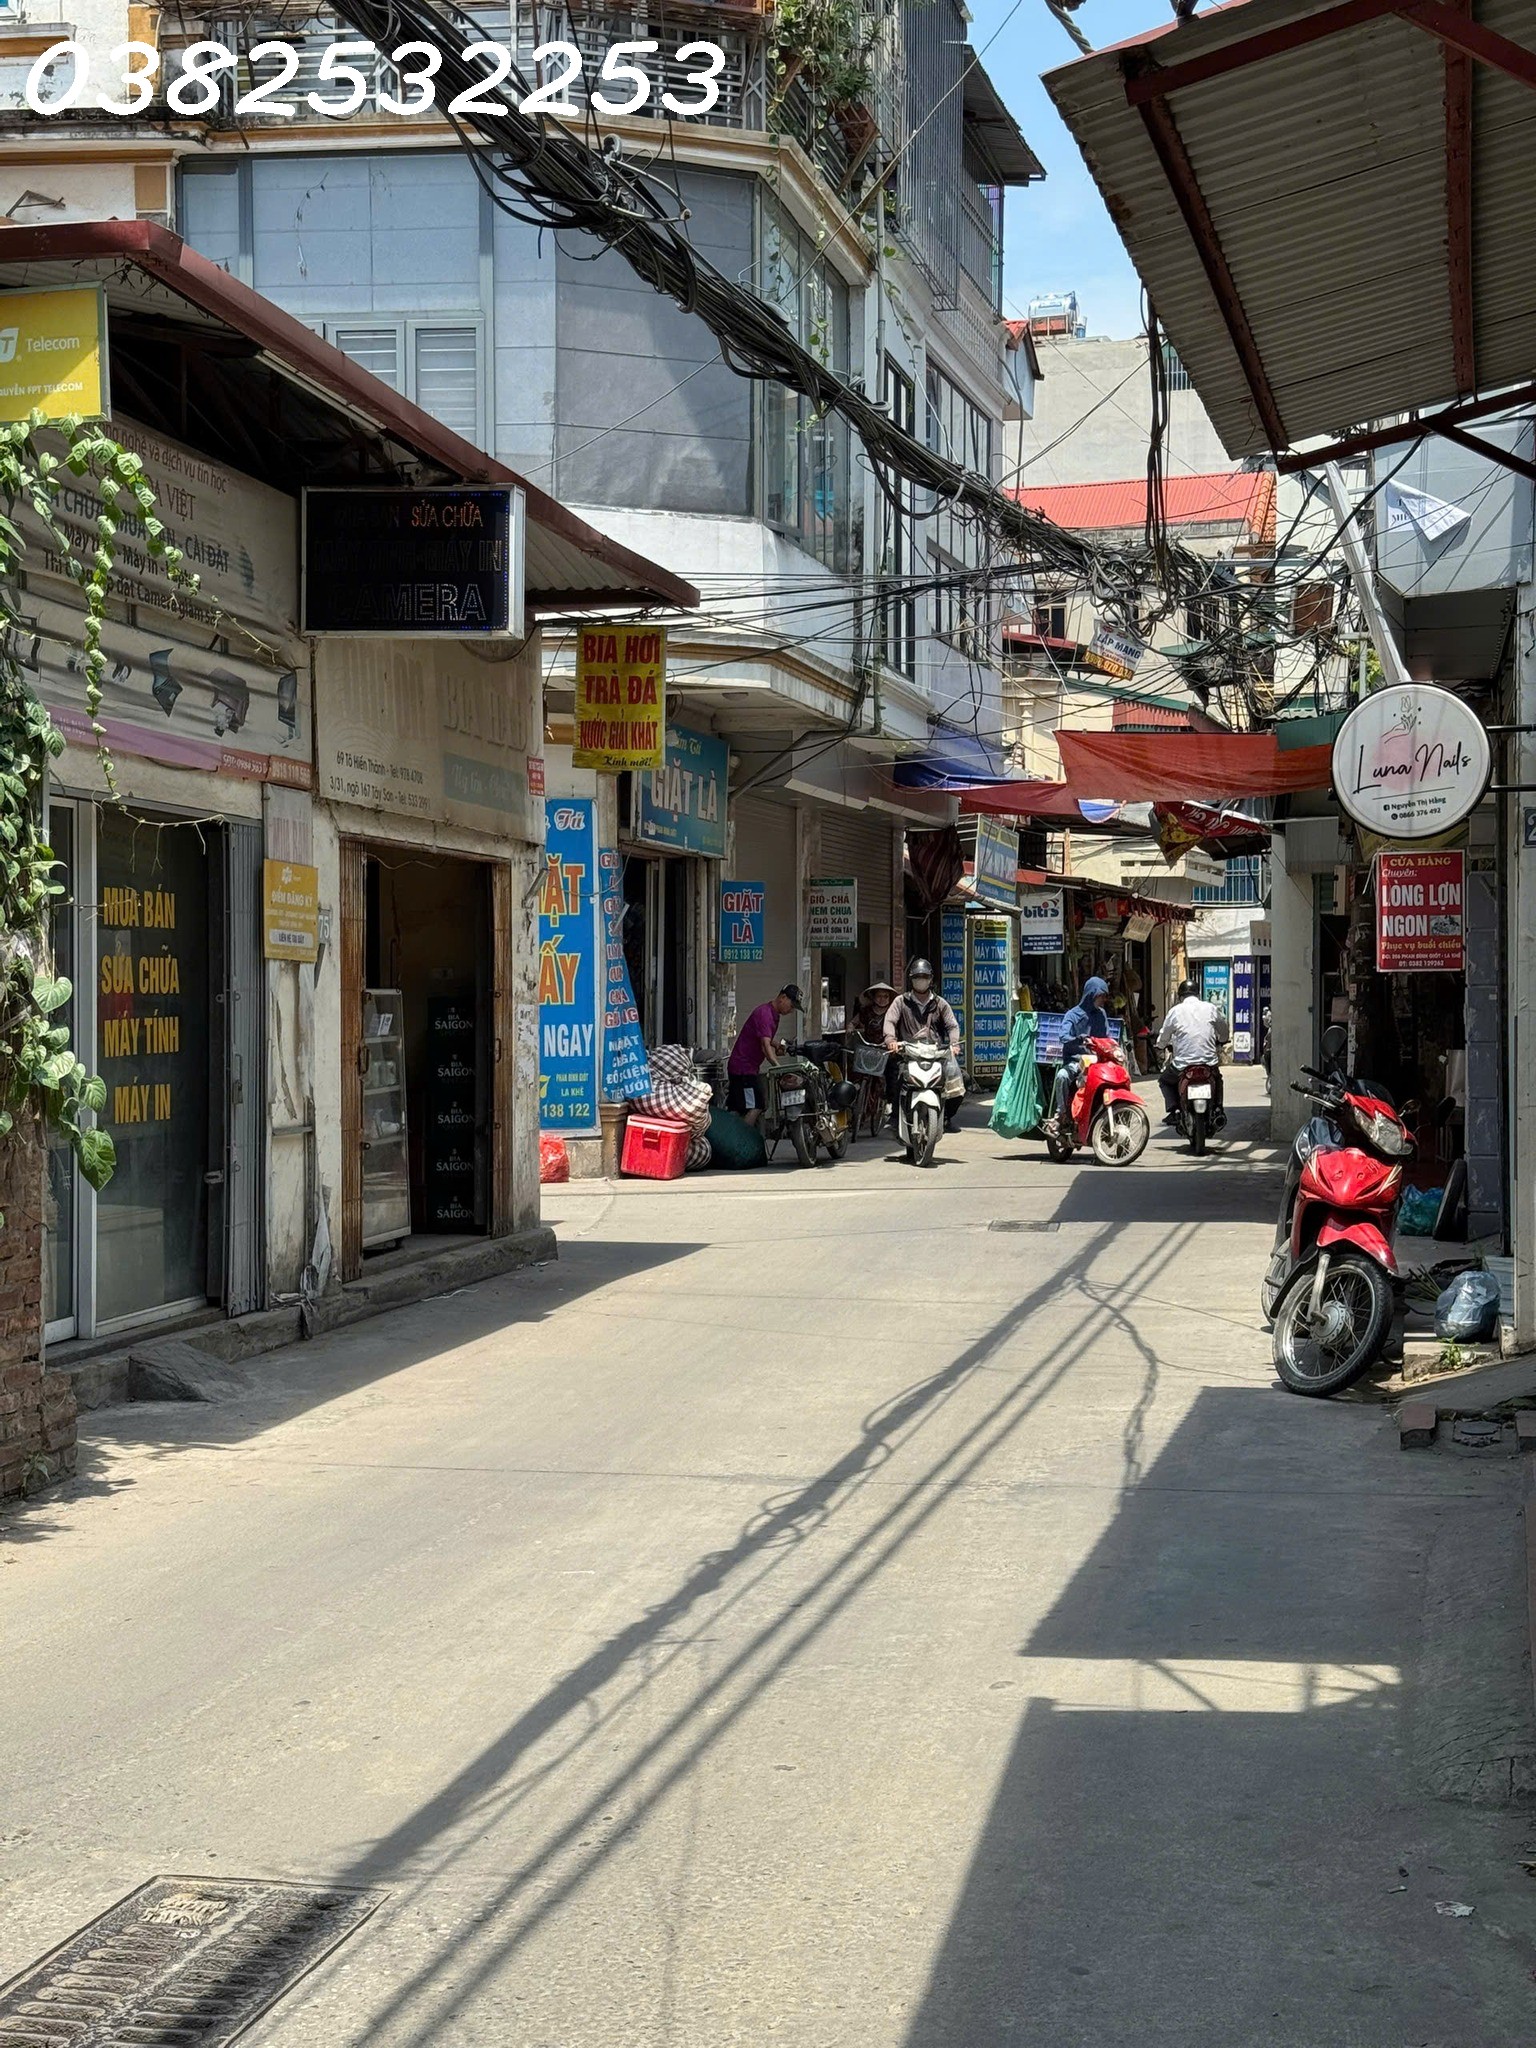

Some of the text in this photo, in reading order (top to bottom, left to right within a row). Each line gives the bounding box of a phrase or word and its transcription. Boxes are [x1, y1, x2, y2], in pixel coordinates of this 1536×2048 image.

[27, 336, 80, 353] Telecom
[27, 384, 42, 395] FPT
[43, 381, 83, 394] TELECOM
[162, 449, 182, 472] dịch
[197, 464, 209, 484] tin
[166, 483, 196, 522] VIỆT
[411, 498, 484, 528] SỬA CHỮA
[64, 520, 89, 554] Máy
[123, 544, 146, 576] Máy
[116, 509, 146, 541] MUA
[185, 534, 205, 564] CÀI
[207, 543, 230, 578] ĐẶT
[137, 580, 177, 613] Camera
[583, 633, 661, 664] BIA HƠI
[584, 668, 658, 705] TRÀ ĐÁ
[580, 711, 607, 750] NƯỚC
[608, 707, 629, 750] GIẢI
[631, 714, 658, 750] KHÁT
[337, 750, 345, 764] 69
[629, 756, 653, 768] mời!
[1352, 741, 1472, 794] Luna Nails
[651, 755, 718, 824] GIẶT LÀ
[1389, 855, 1451, 868] CỬA HÀNG
[103, 883, 176, 930] MUA BÁN
[1381, 879, 1461, 911] LÒNG LỢN
[319, 914, 330, 940] 75
[723, 889, 764, 944] GIẶT LÀ
[1381, 914, 1428, 938] NGON
[974, 942, 1006, 960] MÁY TÍNH
[1404, 942, 1416, 951] vụ
[138, 944, 180, 995] CHỮA
[539, 933, 581, 1006] ẤY
[975, 966, 1006, 984] MÁY IN
[974, 993, 1006, 1008] CAMERA
[104, 1008, 180, 1058] MÁY TÍNH
[434, 1020, 474, 1030] SAIGON
[544, 1023, 594, 1058] NGAY
[974, 1041, 989, 1051] PHỤ
[437, 1067, 476, 1078] SAIGON
[114, 1075, 171, 1125] MÁY IN
[561, 1087, 570, 1097] LA
[437, 1113, 475, 1124] SAIGON
[542, 1102, 590, 1118] 138 122
[435, 1161, 474, 1171] SAIGON
[436, 1208, 474, 1219] SAIGON
